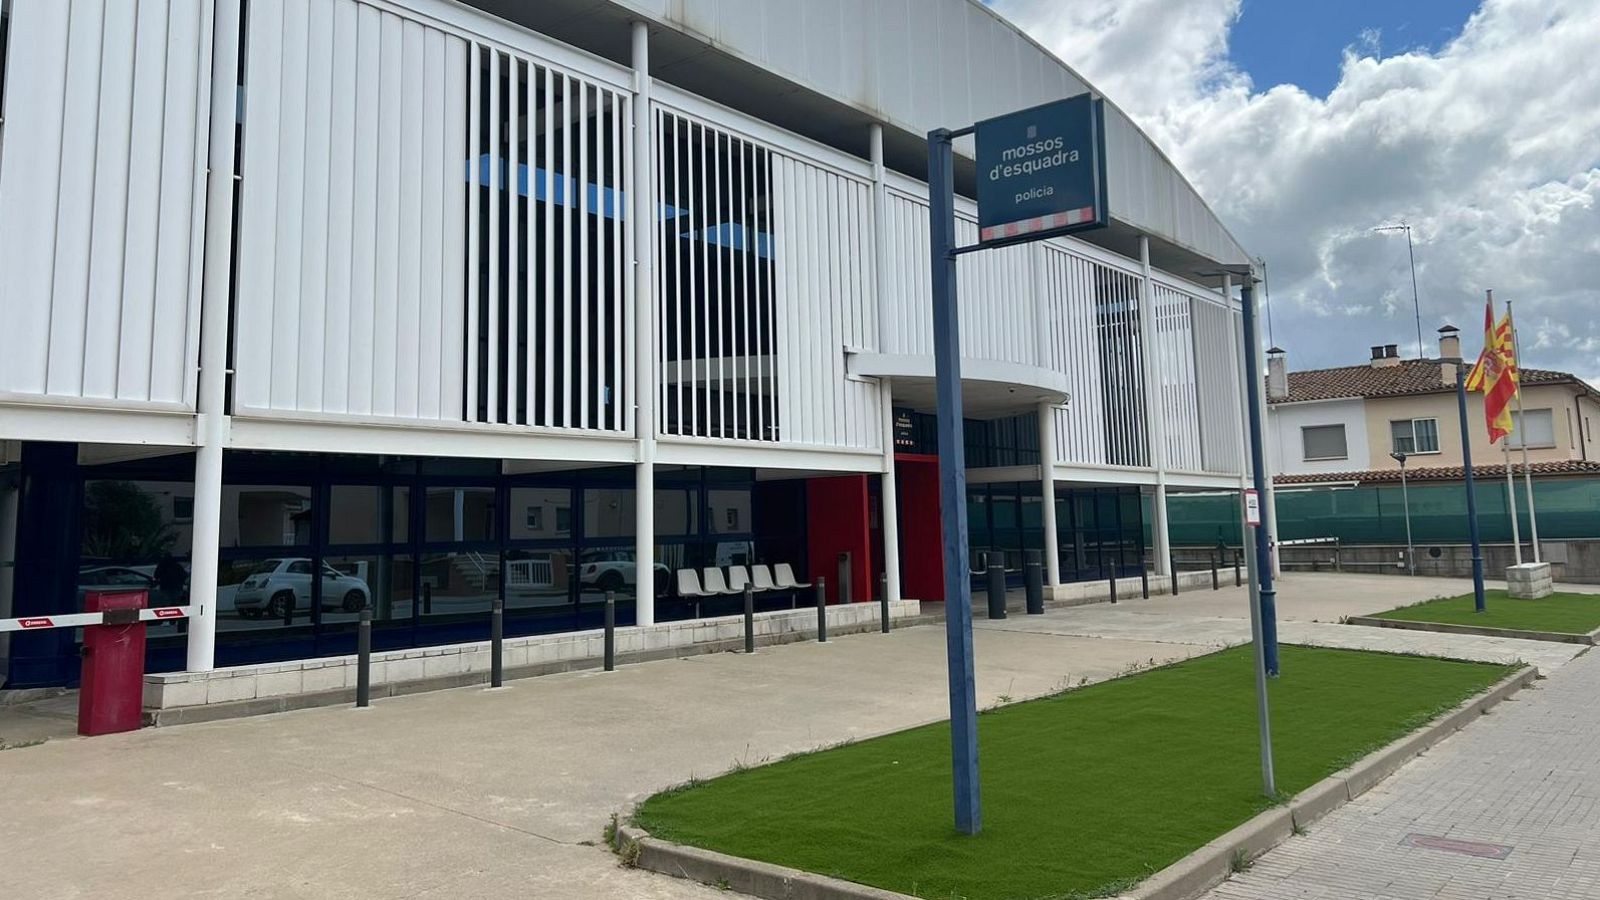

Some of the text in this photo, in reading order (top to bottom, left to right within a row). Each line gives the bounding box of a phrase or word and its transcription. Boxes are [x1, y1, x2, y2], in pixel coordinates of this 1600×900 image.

[1002, 136, 1063, 161] mossos
[989, 149, 1079, 180] d'esquadra
[1015, 186, 1054, 204] policia
